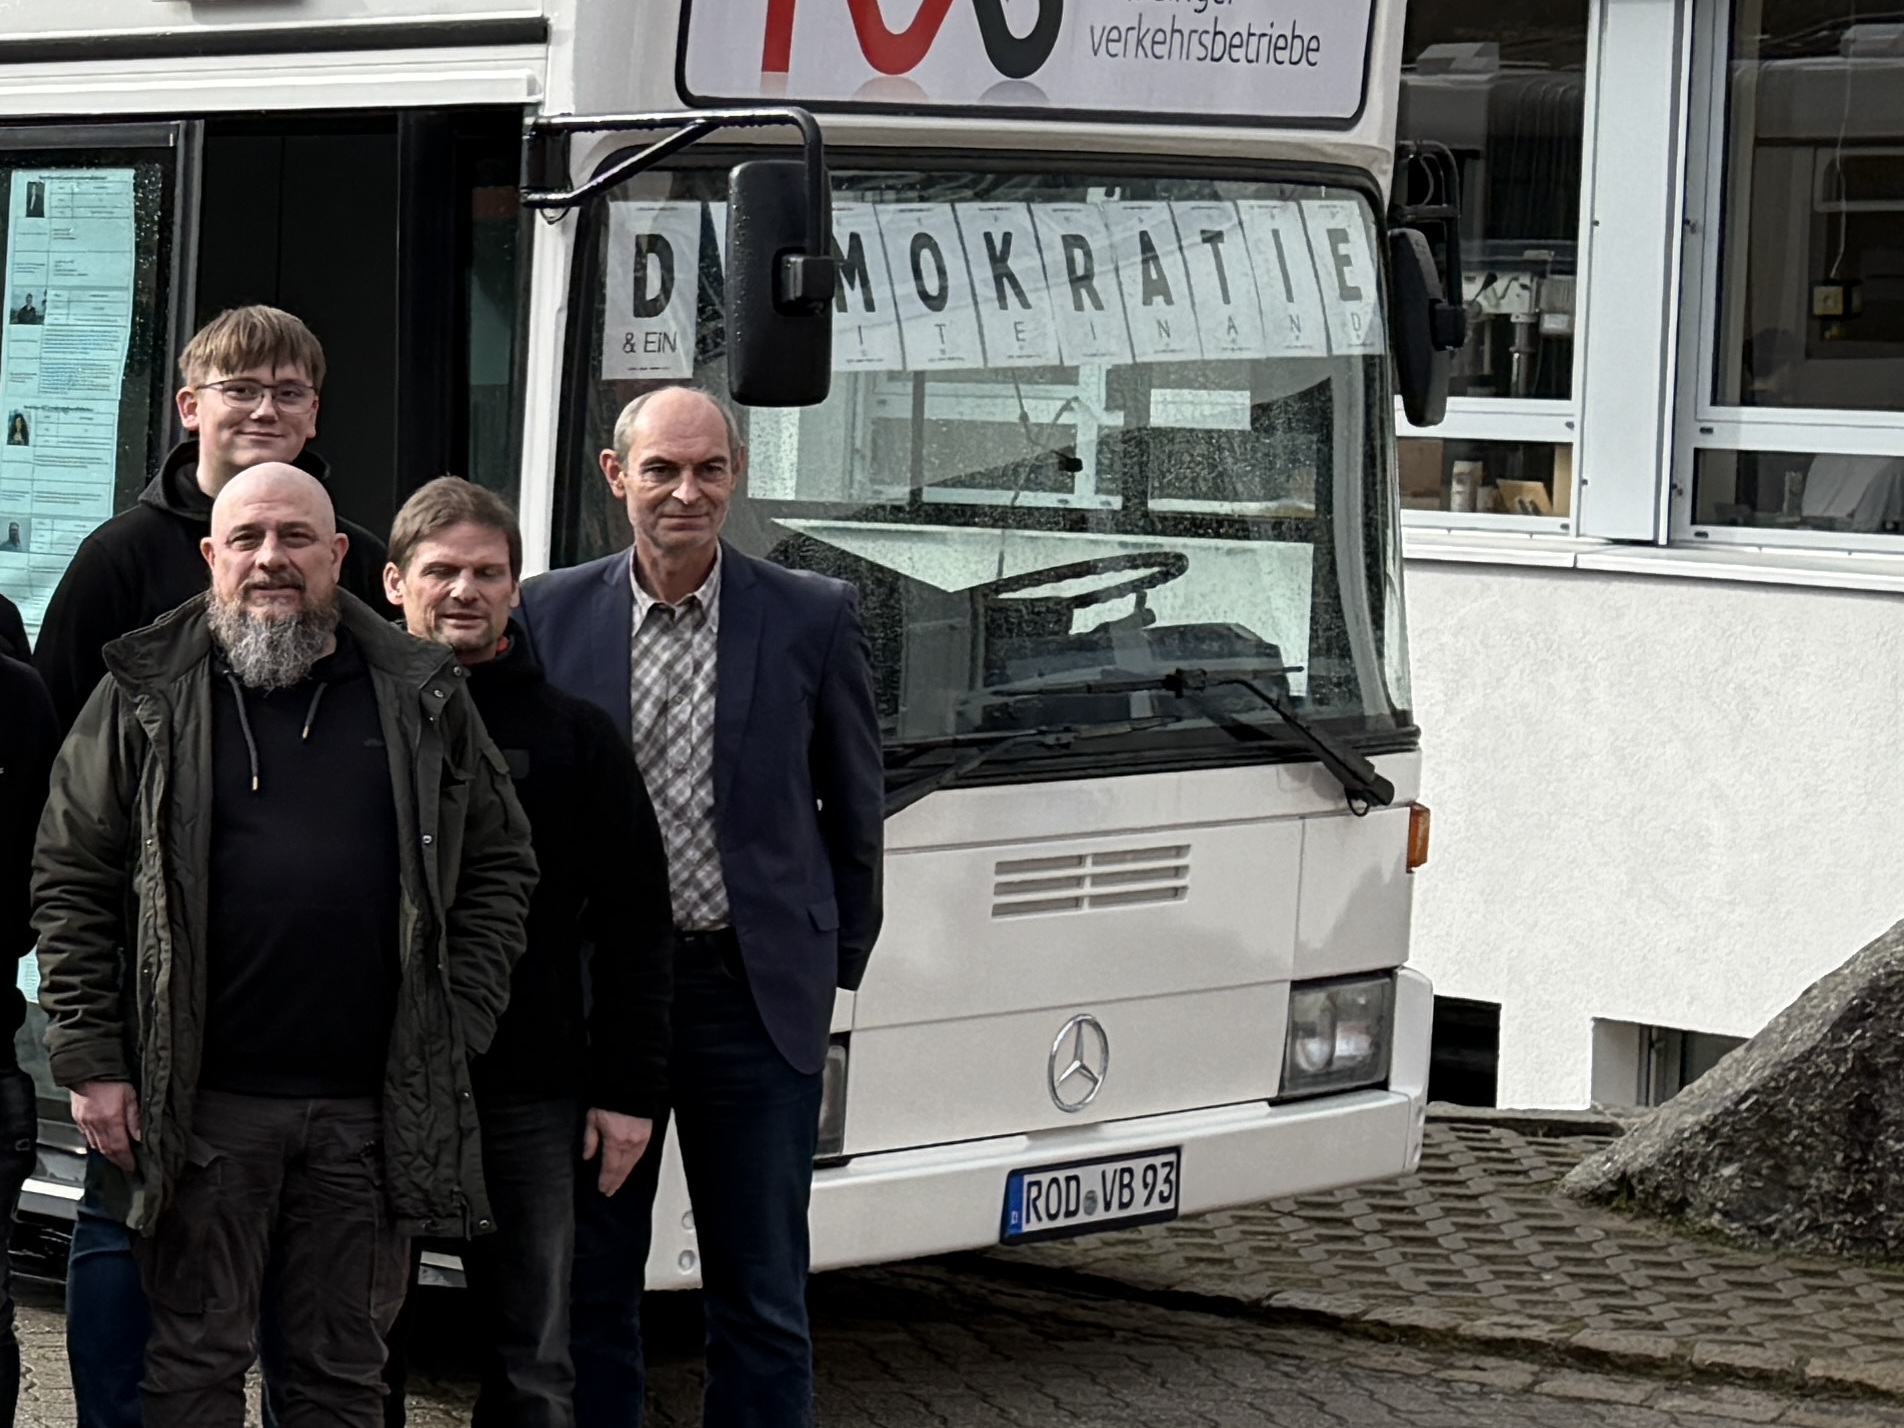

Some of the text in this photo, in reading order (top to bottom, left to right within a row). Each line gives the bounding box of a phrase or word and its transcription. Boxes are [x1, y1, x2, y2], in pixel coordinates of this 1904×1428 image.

[1090, 14, 1321, 67] verkehrsbetriebe
[1026, 1174, 1081, 1224] ROD
[1102, 1167, 1135, 1212] VB
[1142, 1161, 1175, 1207] 93
